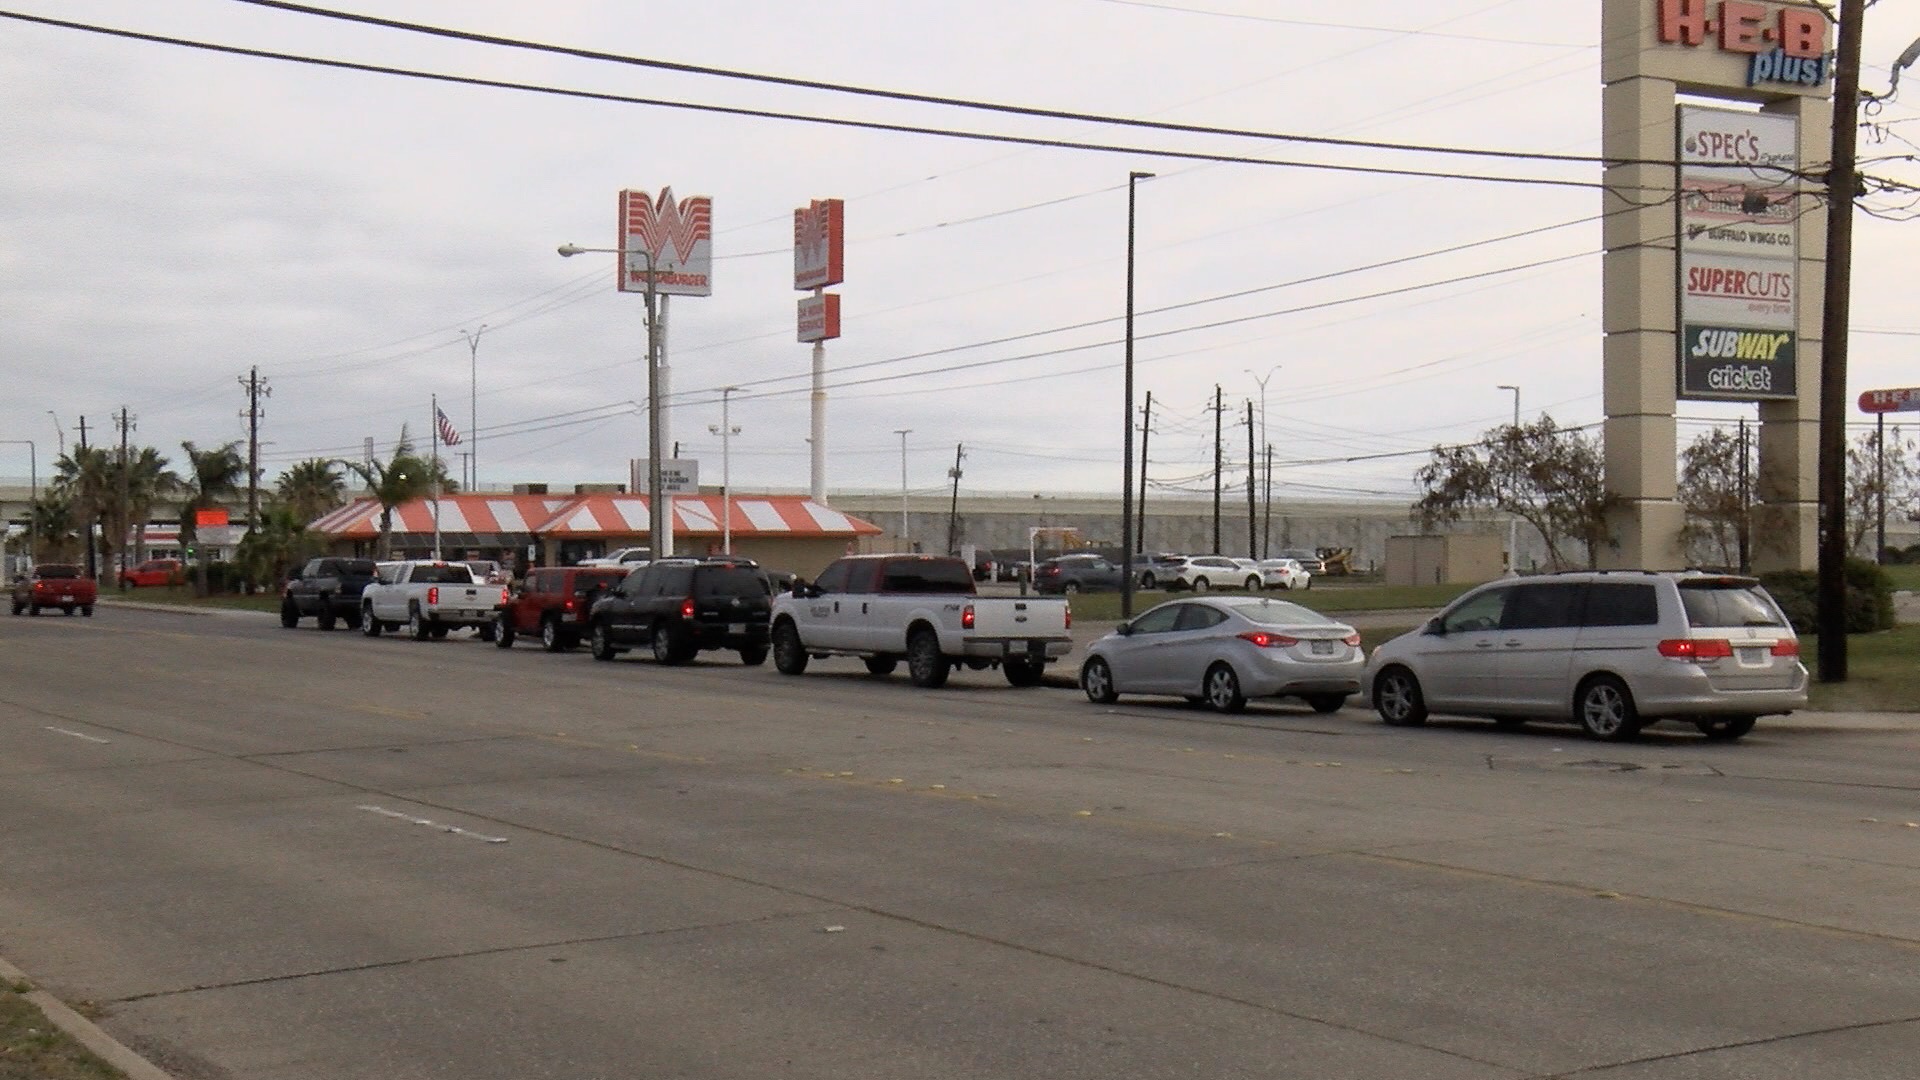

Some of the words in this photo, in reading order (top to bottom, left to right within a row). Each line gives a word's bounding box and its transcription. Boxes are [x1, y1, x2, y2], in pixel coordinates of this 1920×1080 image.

[1697, 129, 1759, 161] SPEC'S
[1687, 266, 1791, 298] SUPERCUTS
[1691, 329, 1790, 360] SUBWAY
[1708, 364, 1772, 390] cricket
